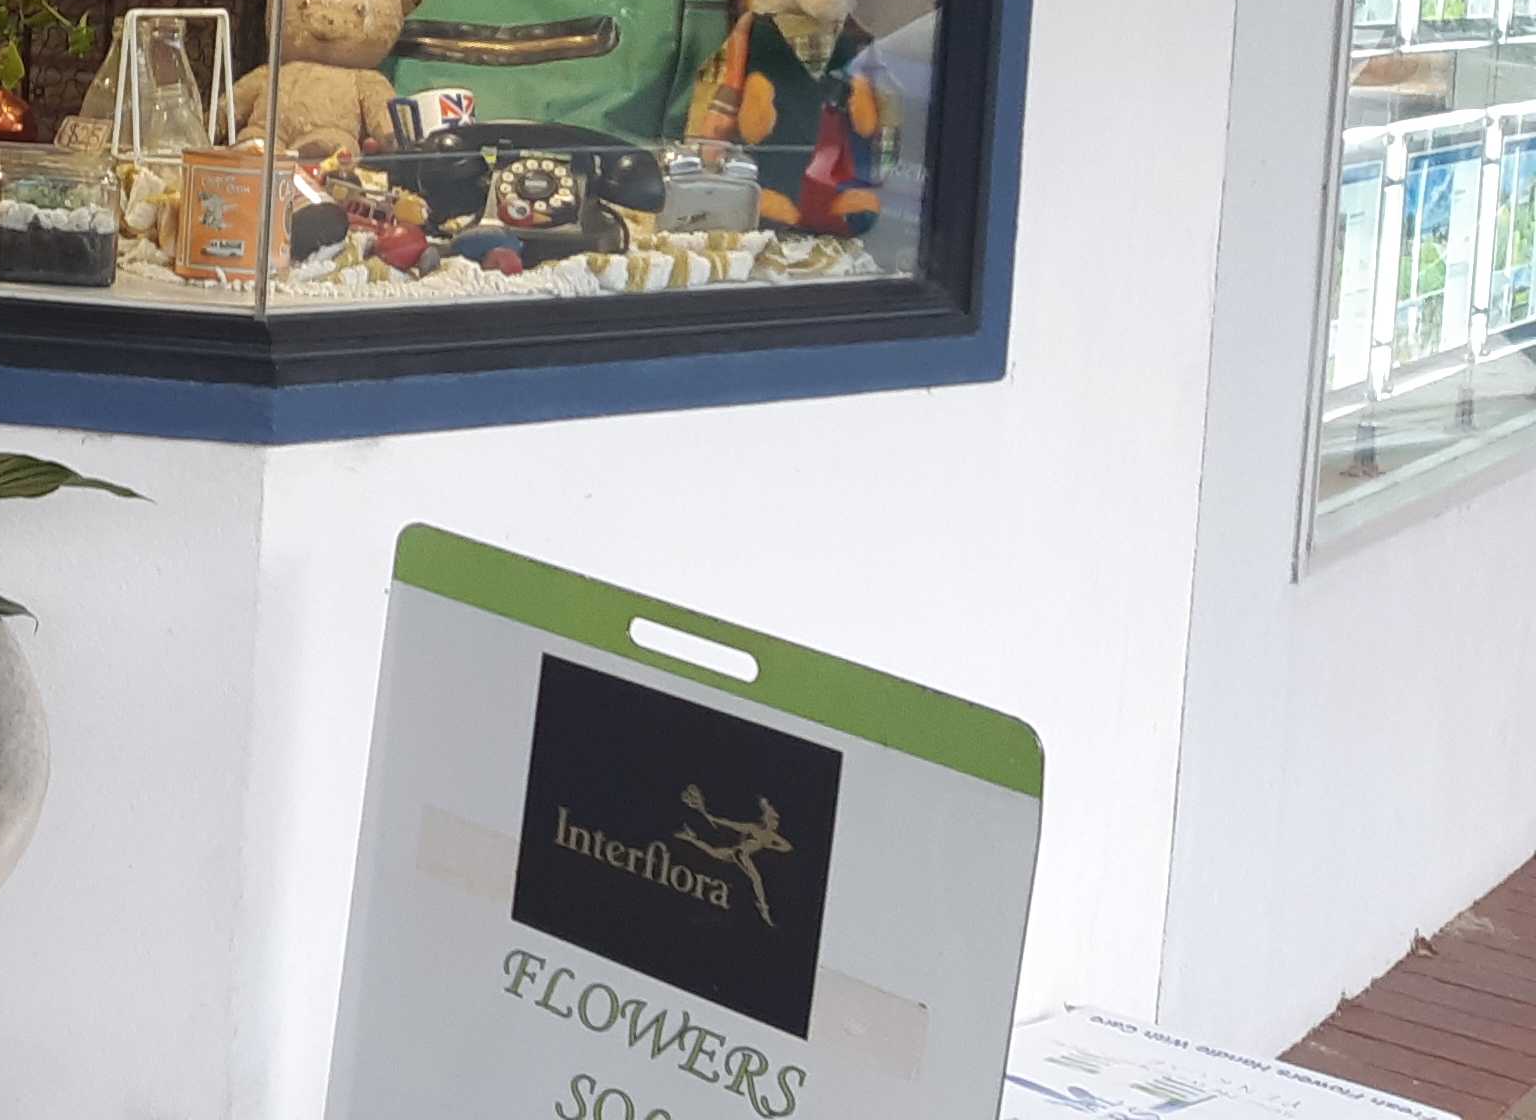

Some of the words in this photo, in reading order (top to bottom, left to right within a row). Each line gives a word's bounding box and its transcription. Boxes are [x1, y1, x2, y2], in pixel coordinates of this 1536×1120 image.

[553, 804, 731, 910] Interflora
[502, 948, 807, 1119] FLOWERS
[1089, 1015, 1139, 1034] Care
[554, 1073, 672, 1120] SO
[1275, 1067, 1365, 1100] Flowers
